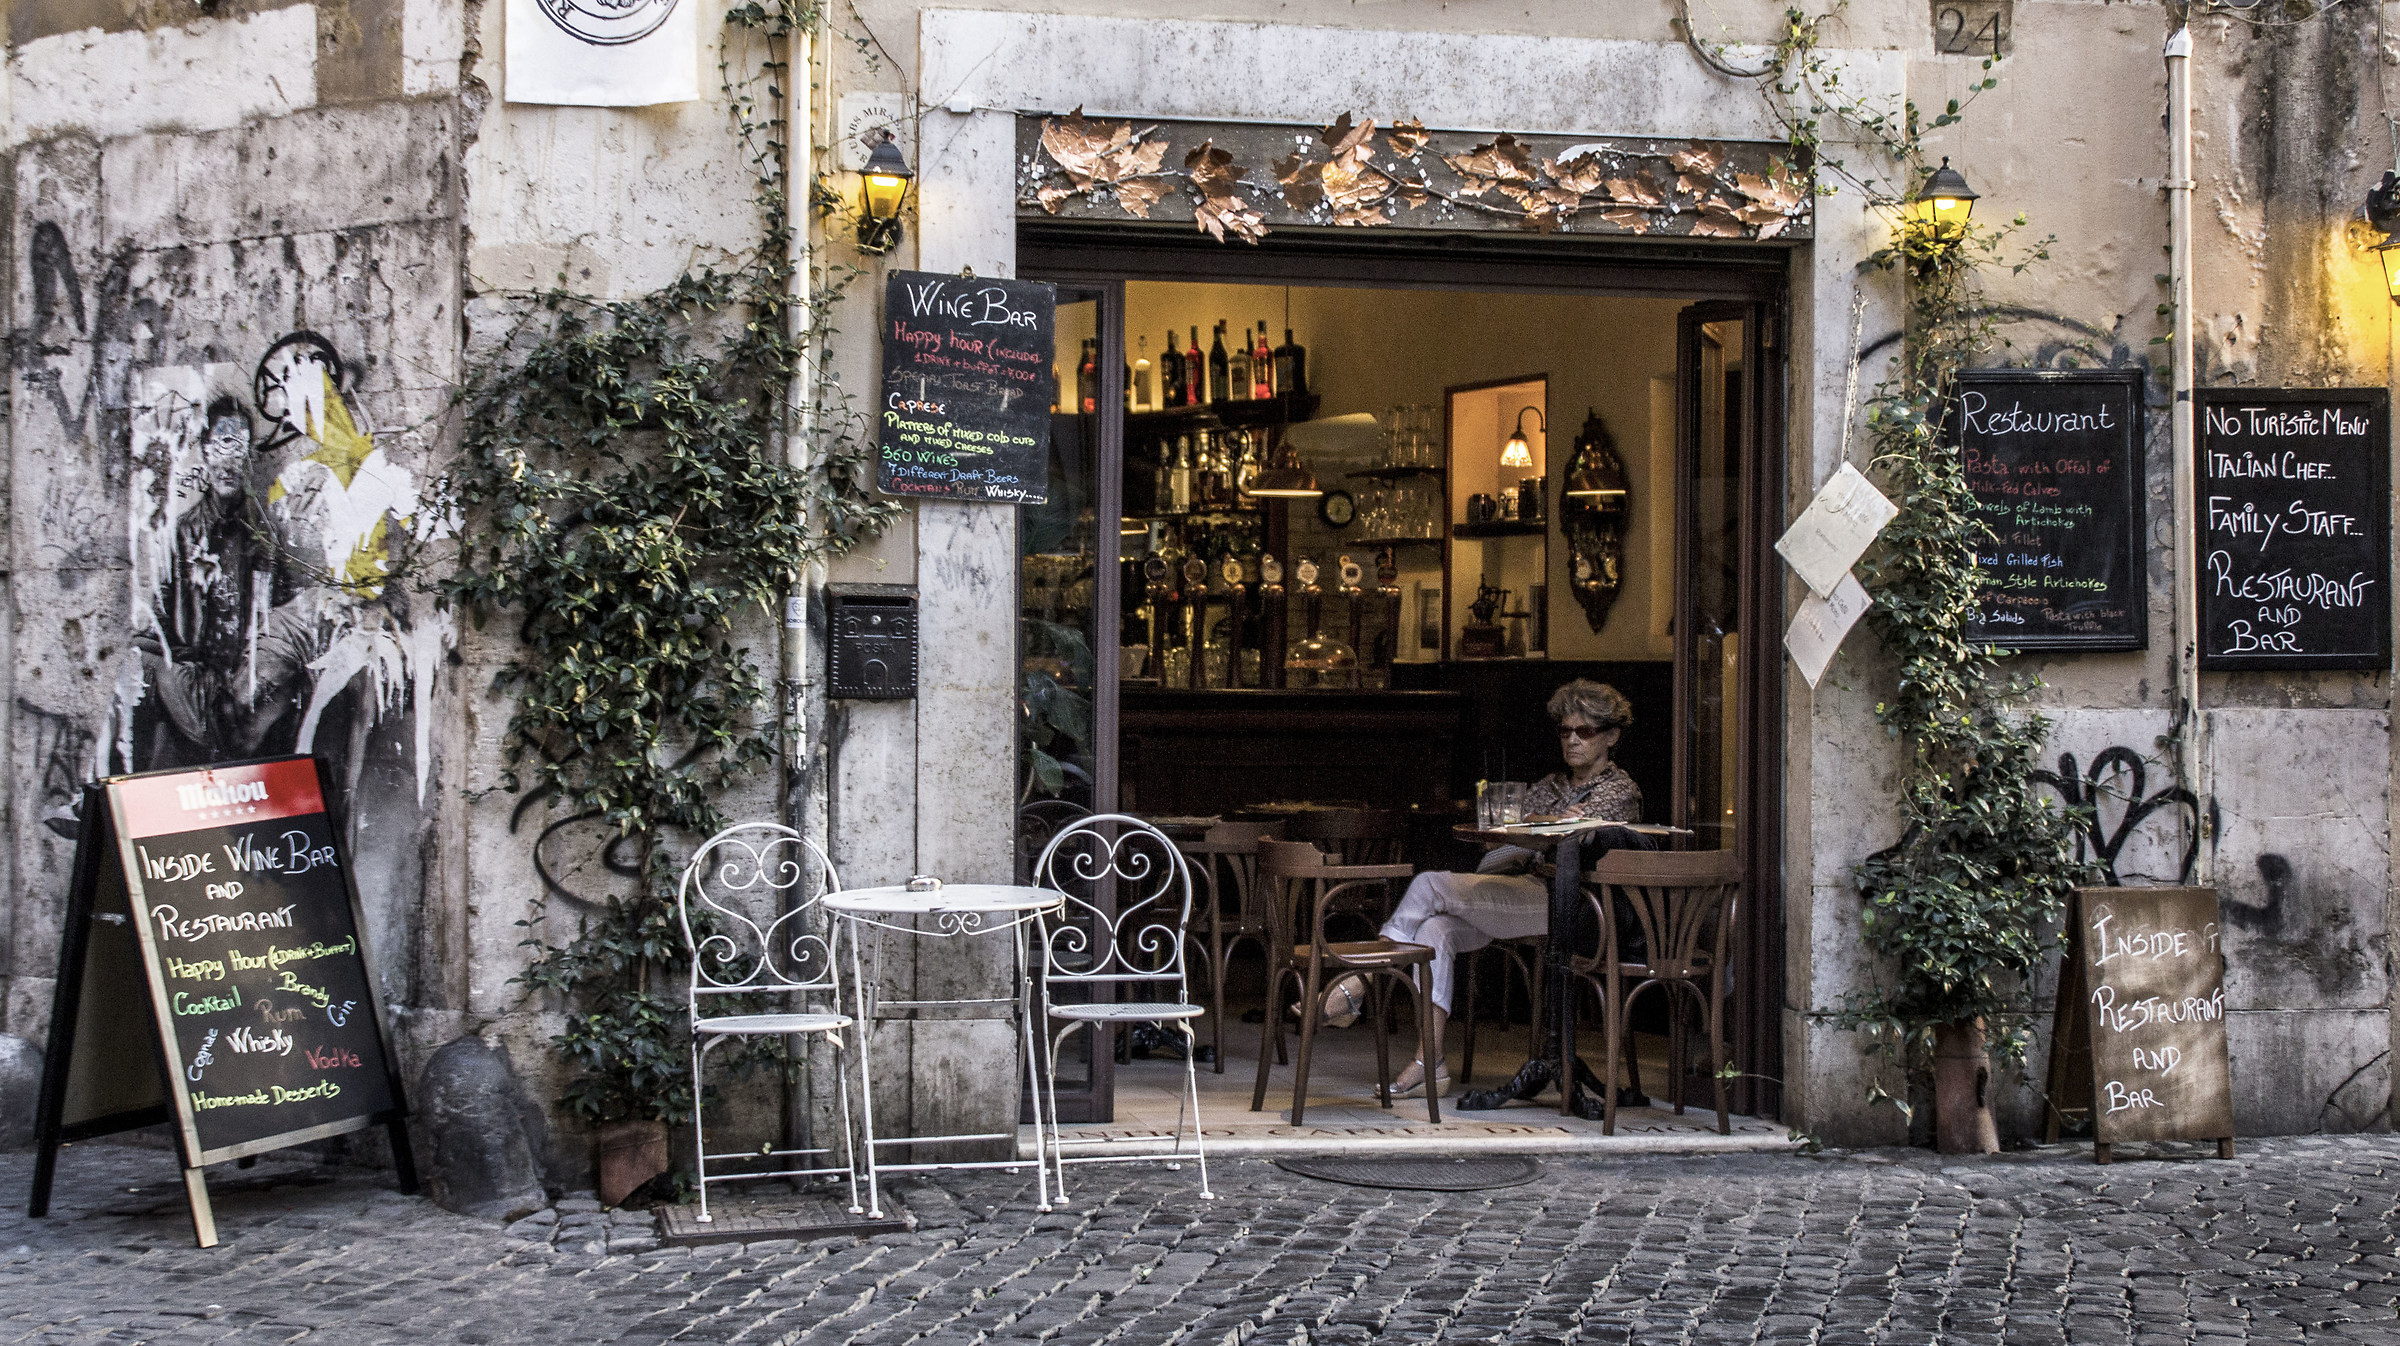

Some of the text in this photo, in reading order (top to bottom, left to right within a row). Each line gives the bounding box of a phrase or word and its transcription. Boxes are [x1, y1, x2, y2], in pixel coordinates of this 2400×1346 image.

[1939, 7, 2002, 56] 24
[1961, 391, 2116, 436] Restaurant
[881, 446, 912, 462] 360
[1965, 449, 2010, 475] Pasta
[2018, 461, 2050, 474] with
[2096, 459, 2112, 473] of
[2015, 501, 2030, 513] of
[2032, 502, 2062, 515] Lamb
[2065, 503, 2092, 516] with
[2015, 514, 2076, 529] Artichokes
[2006, 552, 2038, 566] Grilled
[2040, 553, 2063, 568] Fish
[2003, 573, 2037, 589] Style
[2043, 575, 2108, 591] Artichokes
[1965, 606, 2025, 625] Big Salads
[2257, 603, 2301, 628] AND
[176, 778, 270, 811] Mahou
[205, 881, 244, 900] AND
[166, 956, 226, 981] Happy
[275, 971, 330, 1008] Brandy
[254, 998, 306, 1024] Rum
[326, 999, 357, 1027] Gin
[2132, 1046, 2181, 1078] AND
[270, 1078, 341, 1105] Desserts
